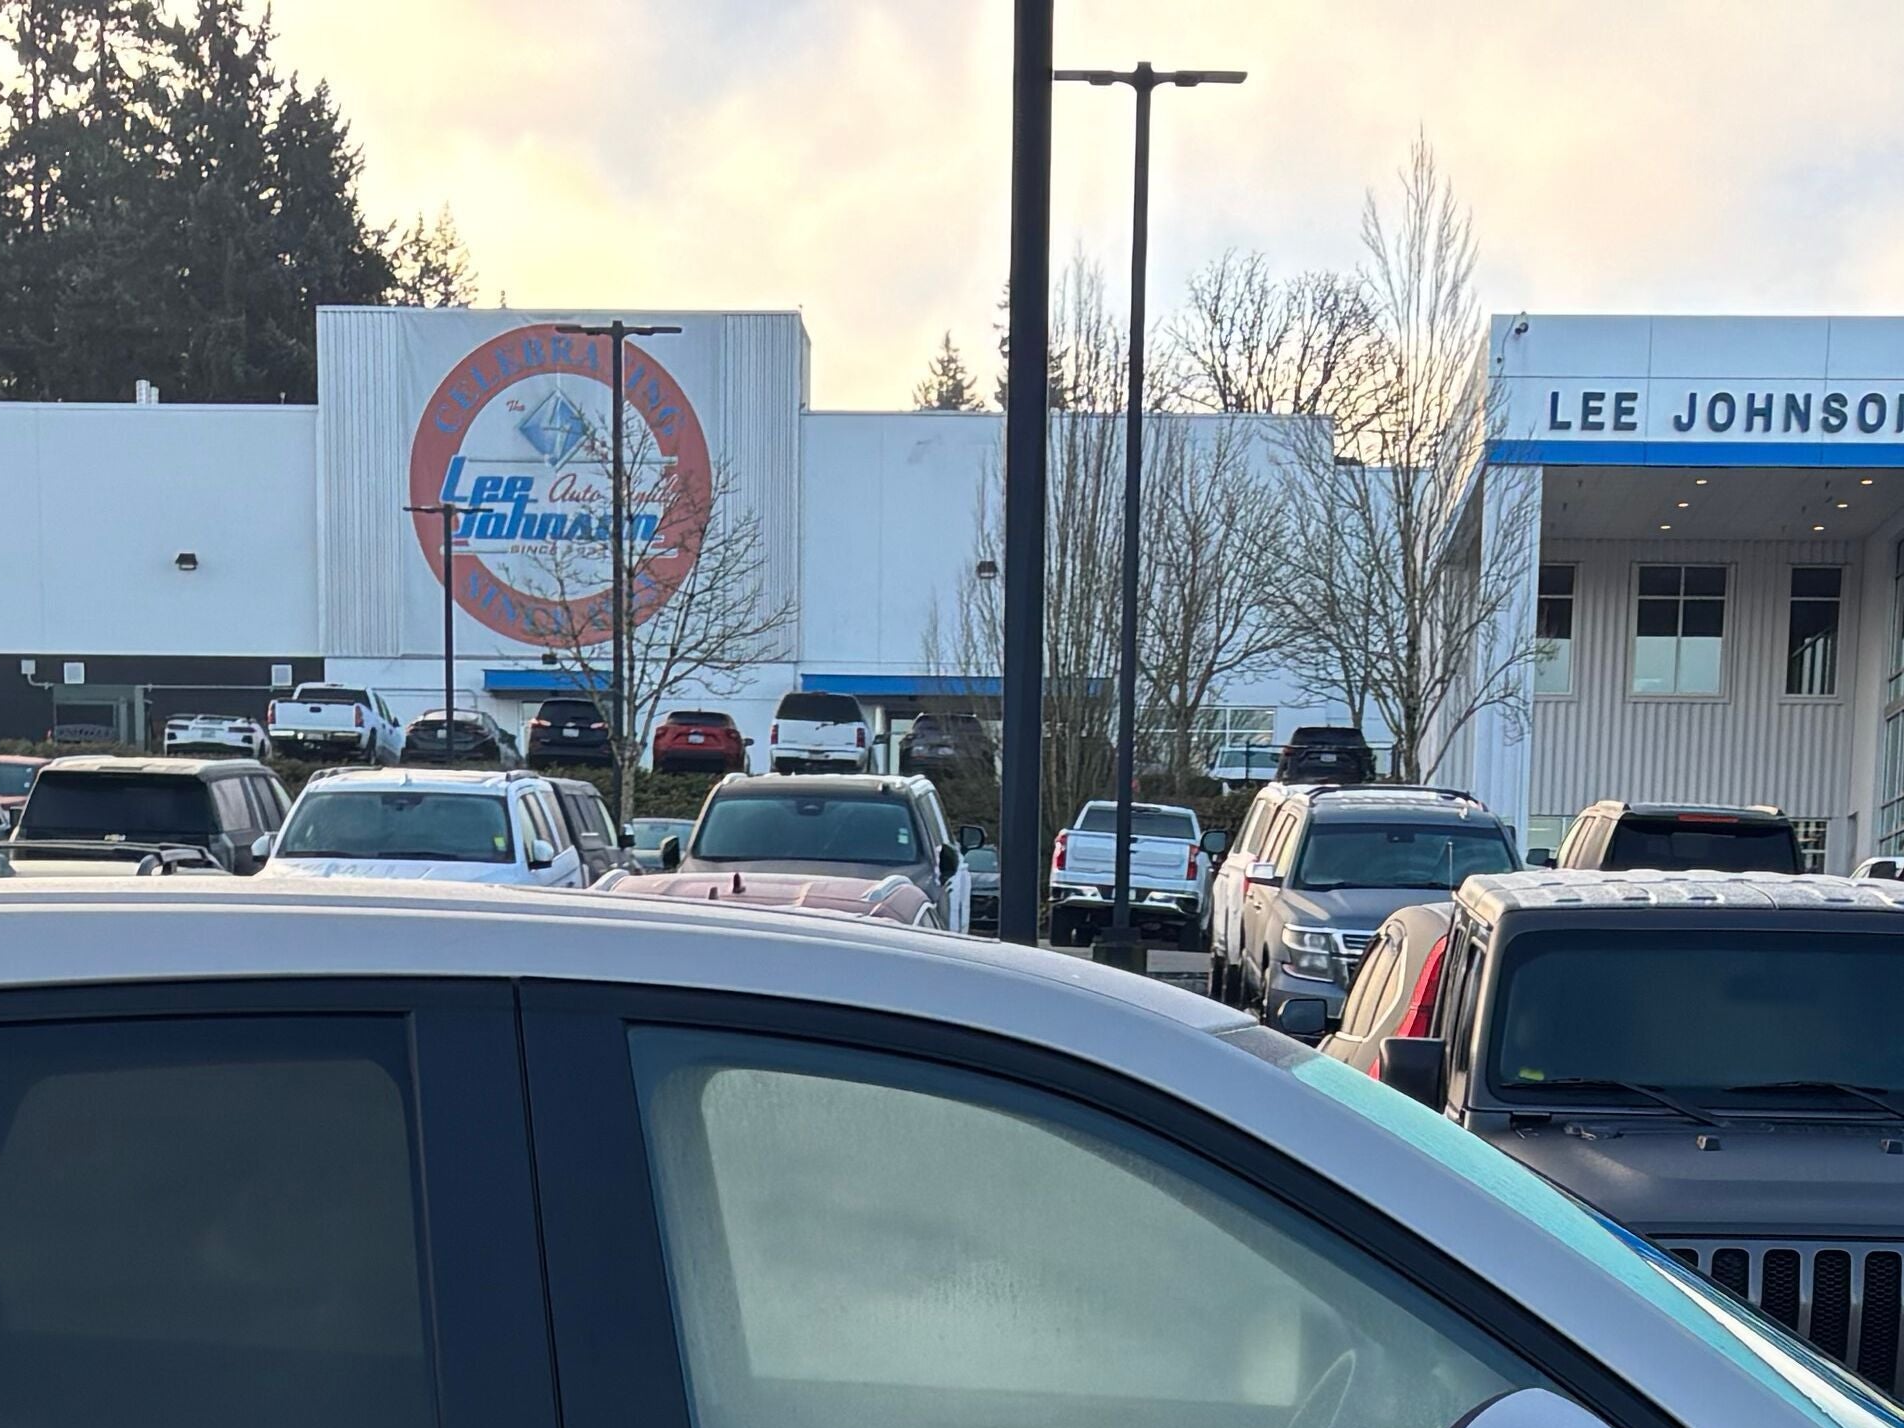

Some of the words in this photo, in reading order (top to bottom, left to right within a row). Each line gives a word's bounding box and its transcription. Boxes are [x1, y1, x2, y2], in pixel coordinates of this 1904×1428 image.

[434, 335, 687, 436] CELEBRAING
[1549, 391, 1638, 431] LEE
[440, 456, 538, 502] Lee
[548, 473, 602, 503] Auto
